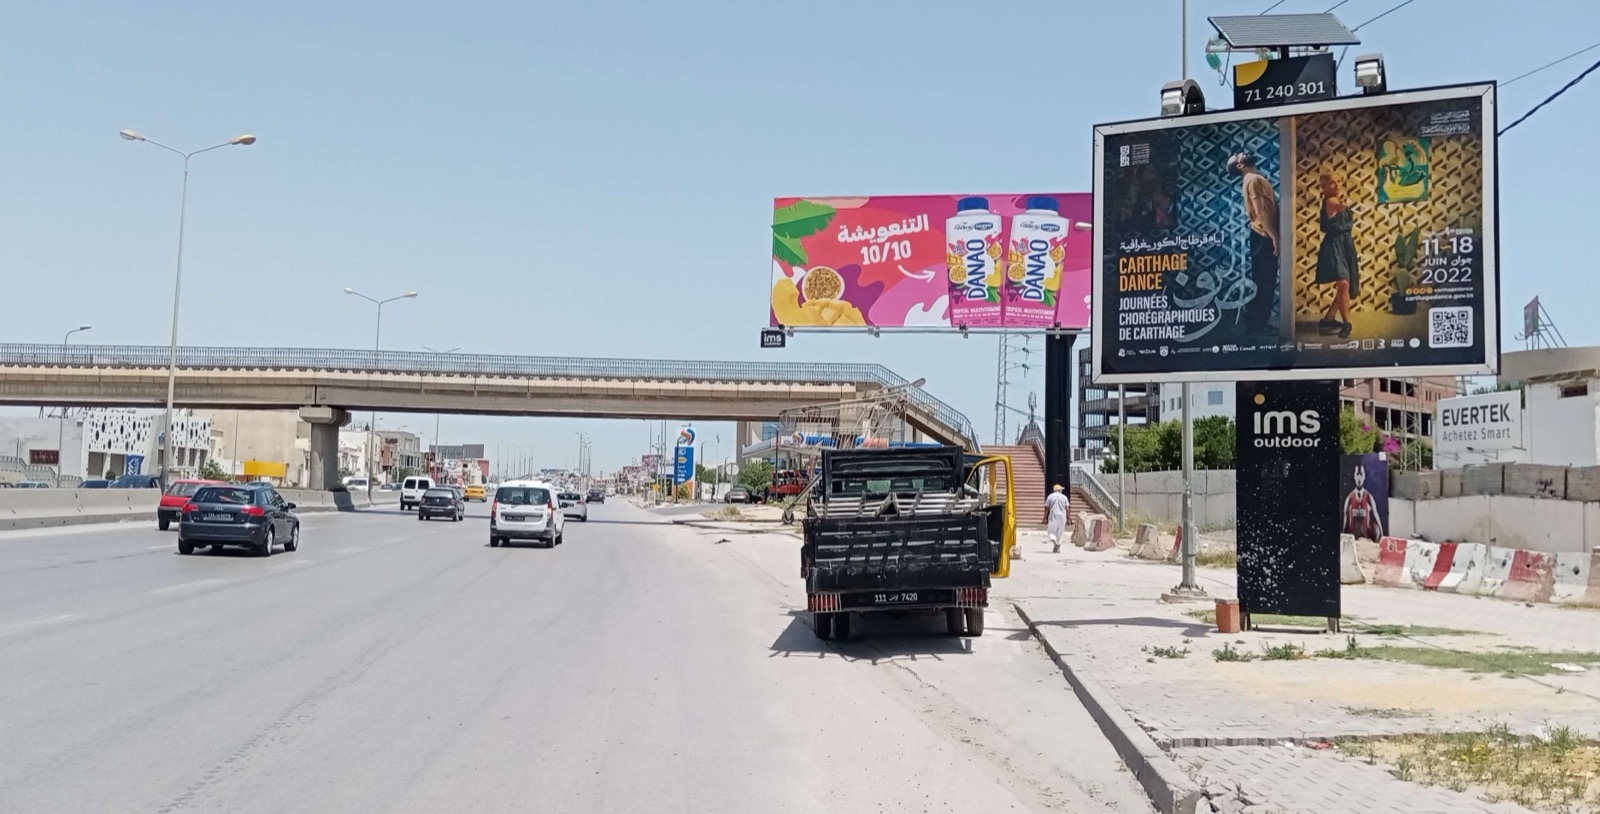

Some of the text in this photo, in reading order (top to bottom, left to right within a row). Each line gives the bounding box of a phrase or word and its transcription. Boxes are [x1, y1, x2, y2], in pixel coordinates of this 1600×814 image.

[1244, 81, 1326, 102] 71 240 301
[837, 213, 929, 243] التنعويشة
[860, 240, 912, 265] 10/10
[1421, 257, 1448, 267] JUIN
[966, 239, 987, 299] DANAO
[1023, 239, 1049, 300] DANAO
[1119, 253, 1188, 275] CARTHAGE
[1119, 273, 1163, 293] DANCE
[1421, 267, 1473, 284] 2022
[1118, 293, 1168, 311] JOURNÉES
[1118, 308, 1216, 326] CHORÉGRAPHIQUES
[763, 333, 781, 343] ims
[1118, 325, 1186, 341] DE CARTHAGE
[1253, 393, 1321, 435] ims
[1442, 402, 1511, 427] EVERTEK
[1254, 436, 1321, 448] outdoor
[1442, 427, 1511, 442] Achetez Smart
[874, 594, 887, 603] 111
[901, 592, 918, 602] 7420
